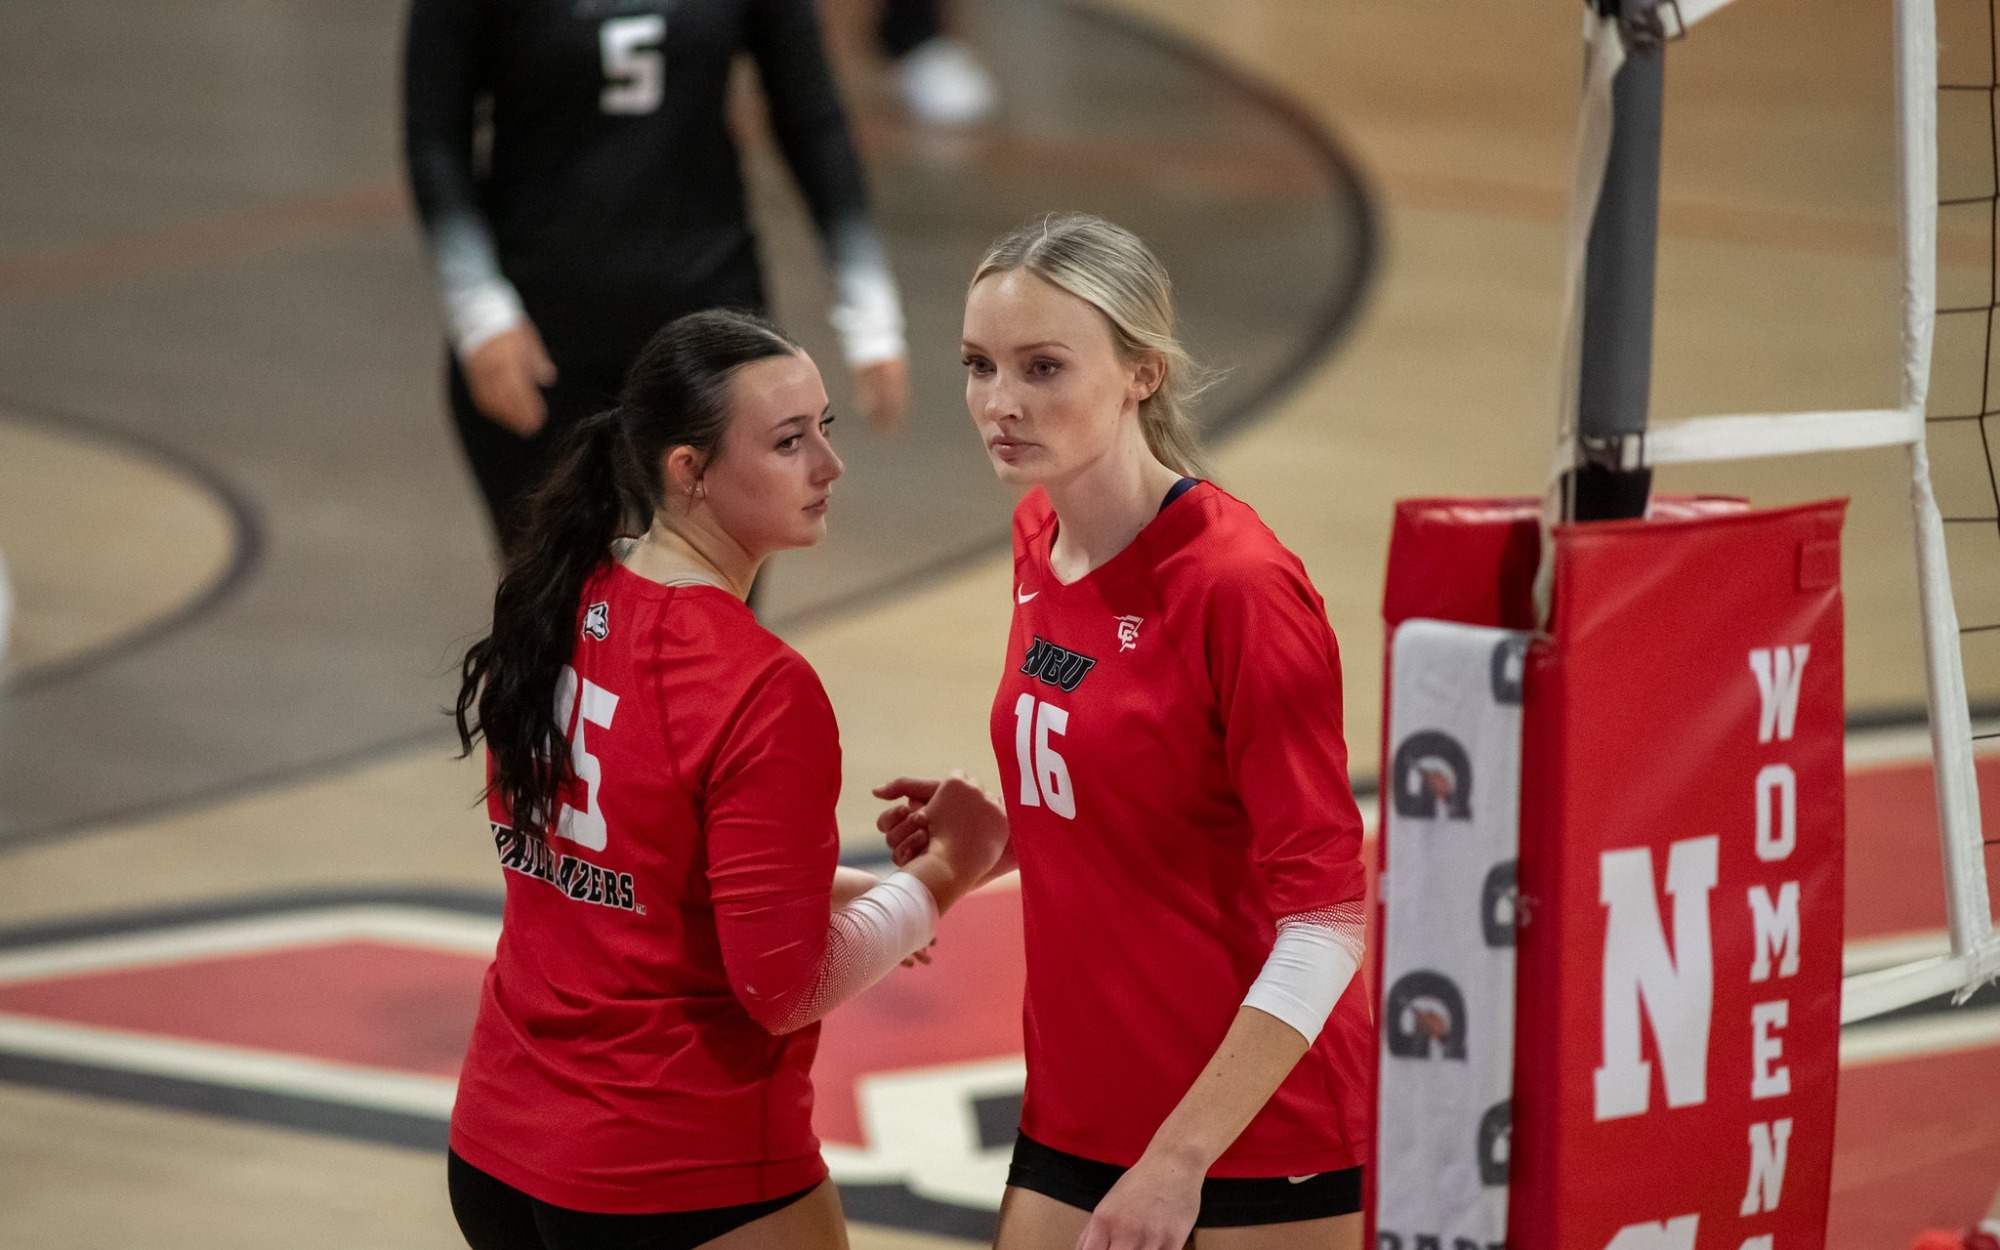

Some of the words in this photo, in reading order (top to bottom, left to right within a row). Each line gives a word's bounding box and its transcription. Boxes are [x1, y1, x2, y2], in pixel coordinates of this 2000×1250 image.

[599, 15, 667, 116] 5
[1020, 635, 1097, 692] NGU
[530, 664, 620, 852] 5
[1014, 692, 1076, 820] 16
[1738, 644, 1811, 1250] WOMEN
